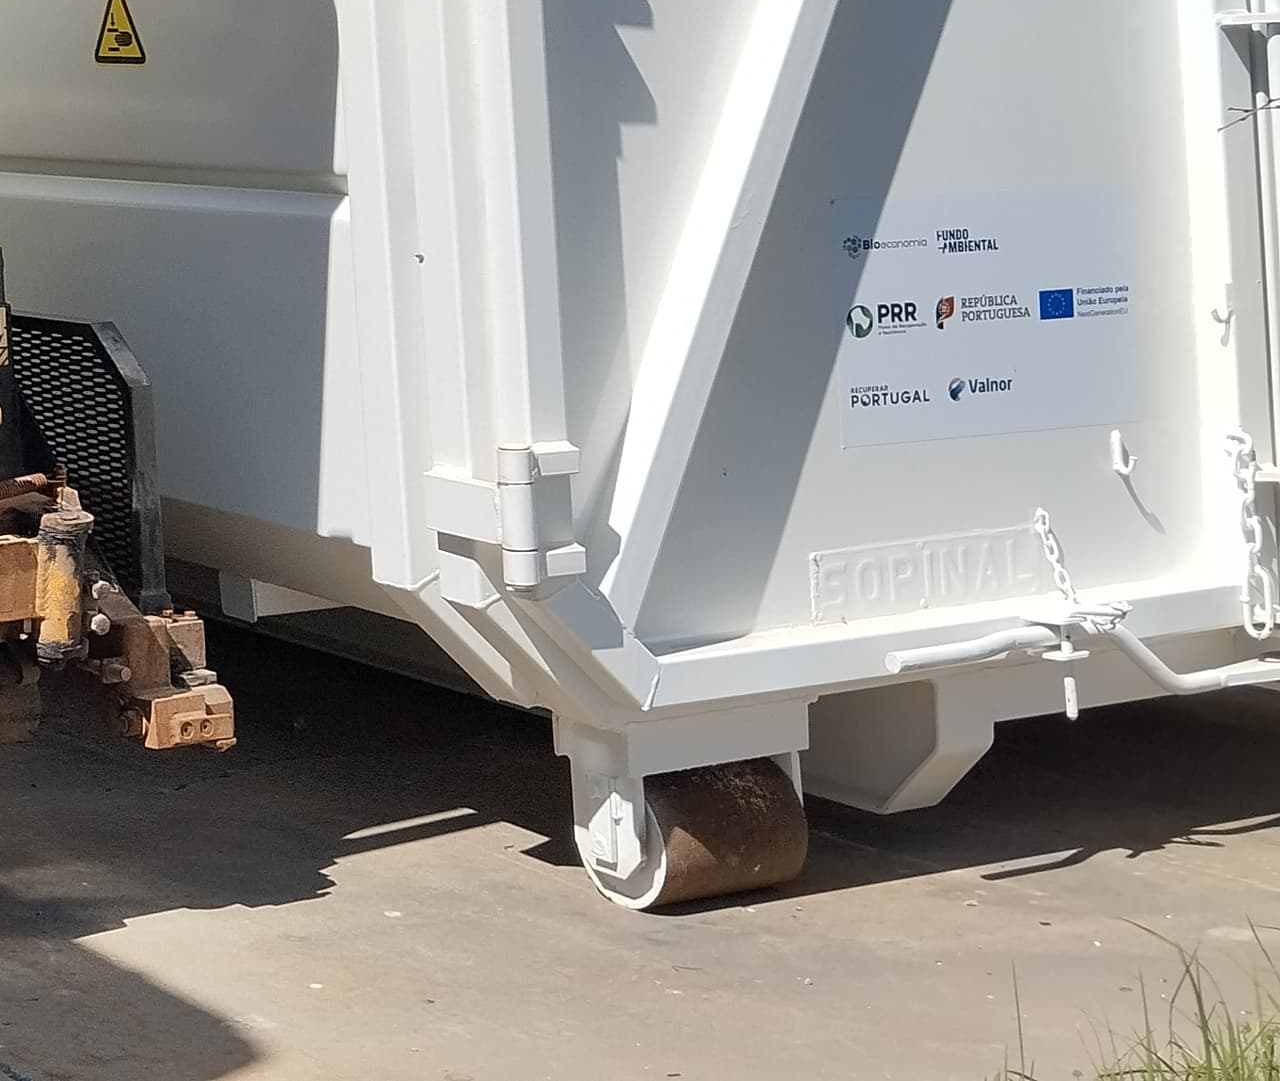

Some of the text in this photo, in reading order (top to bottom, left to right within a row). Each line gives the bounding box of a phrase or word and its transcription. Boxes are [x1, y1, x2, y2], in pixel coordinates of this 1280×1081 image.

[936, 228, 969, 242] FUNDO
[961, 294, 1018, 309] REPÚBLICA
[877, 302, 917, 324] PRR
[962, 307, 1031, 322] PORTUGUESA
[968, 377, 1013, 393] Valnor
[851, 390, 930, 408] PORTUGAL
[821, 539, 1034, 606] SOPINAL
